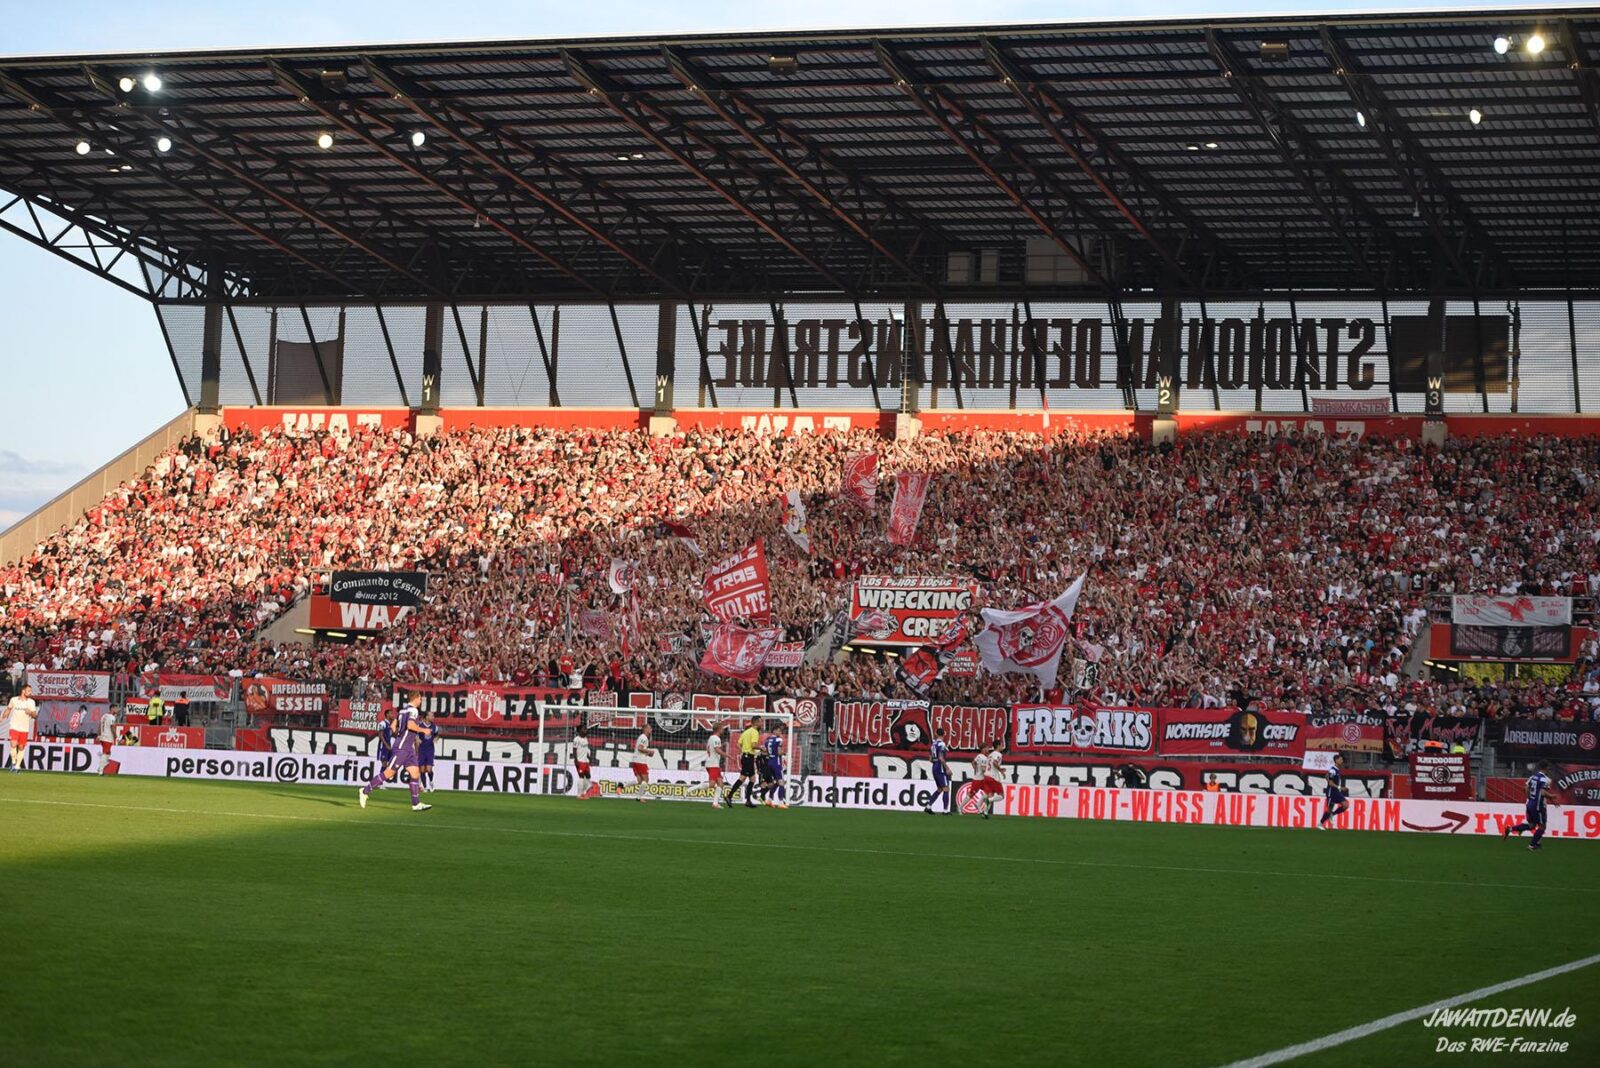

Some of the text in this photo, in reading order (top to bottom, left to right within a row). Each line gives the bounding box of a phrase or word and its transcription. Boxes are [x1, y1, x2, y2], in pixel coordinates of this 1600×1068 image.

[1158, 376, 1172, 388] W
[1427, 377, 1441, 390] W
[1159, 390, 1171, 405] 2
[1428, 391, 1440, 406] 3
[333, 576, 422, 596] Commando Essen
[859, 589, 971, 610] WRECKING
[37, 674, 70, 685] Essener
[275, 696, 323, 711] ESSEN
[828, 701, 1008, 750] JUNGE ESSENER
[1165, 722, 1297, 741] NORTHSIDE CREW
[1504, 726, 1577, 746] ADRENALIN BOYS
[1078, 789, 1203, 823] ROT-WEISS
[1214, 793, 1257, 826] AUF
